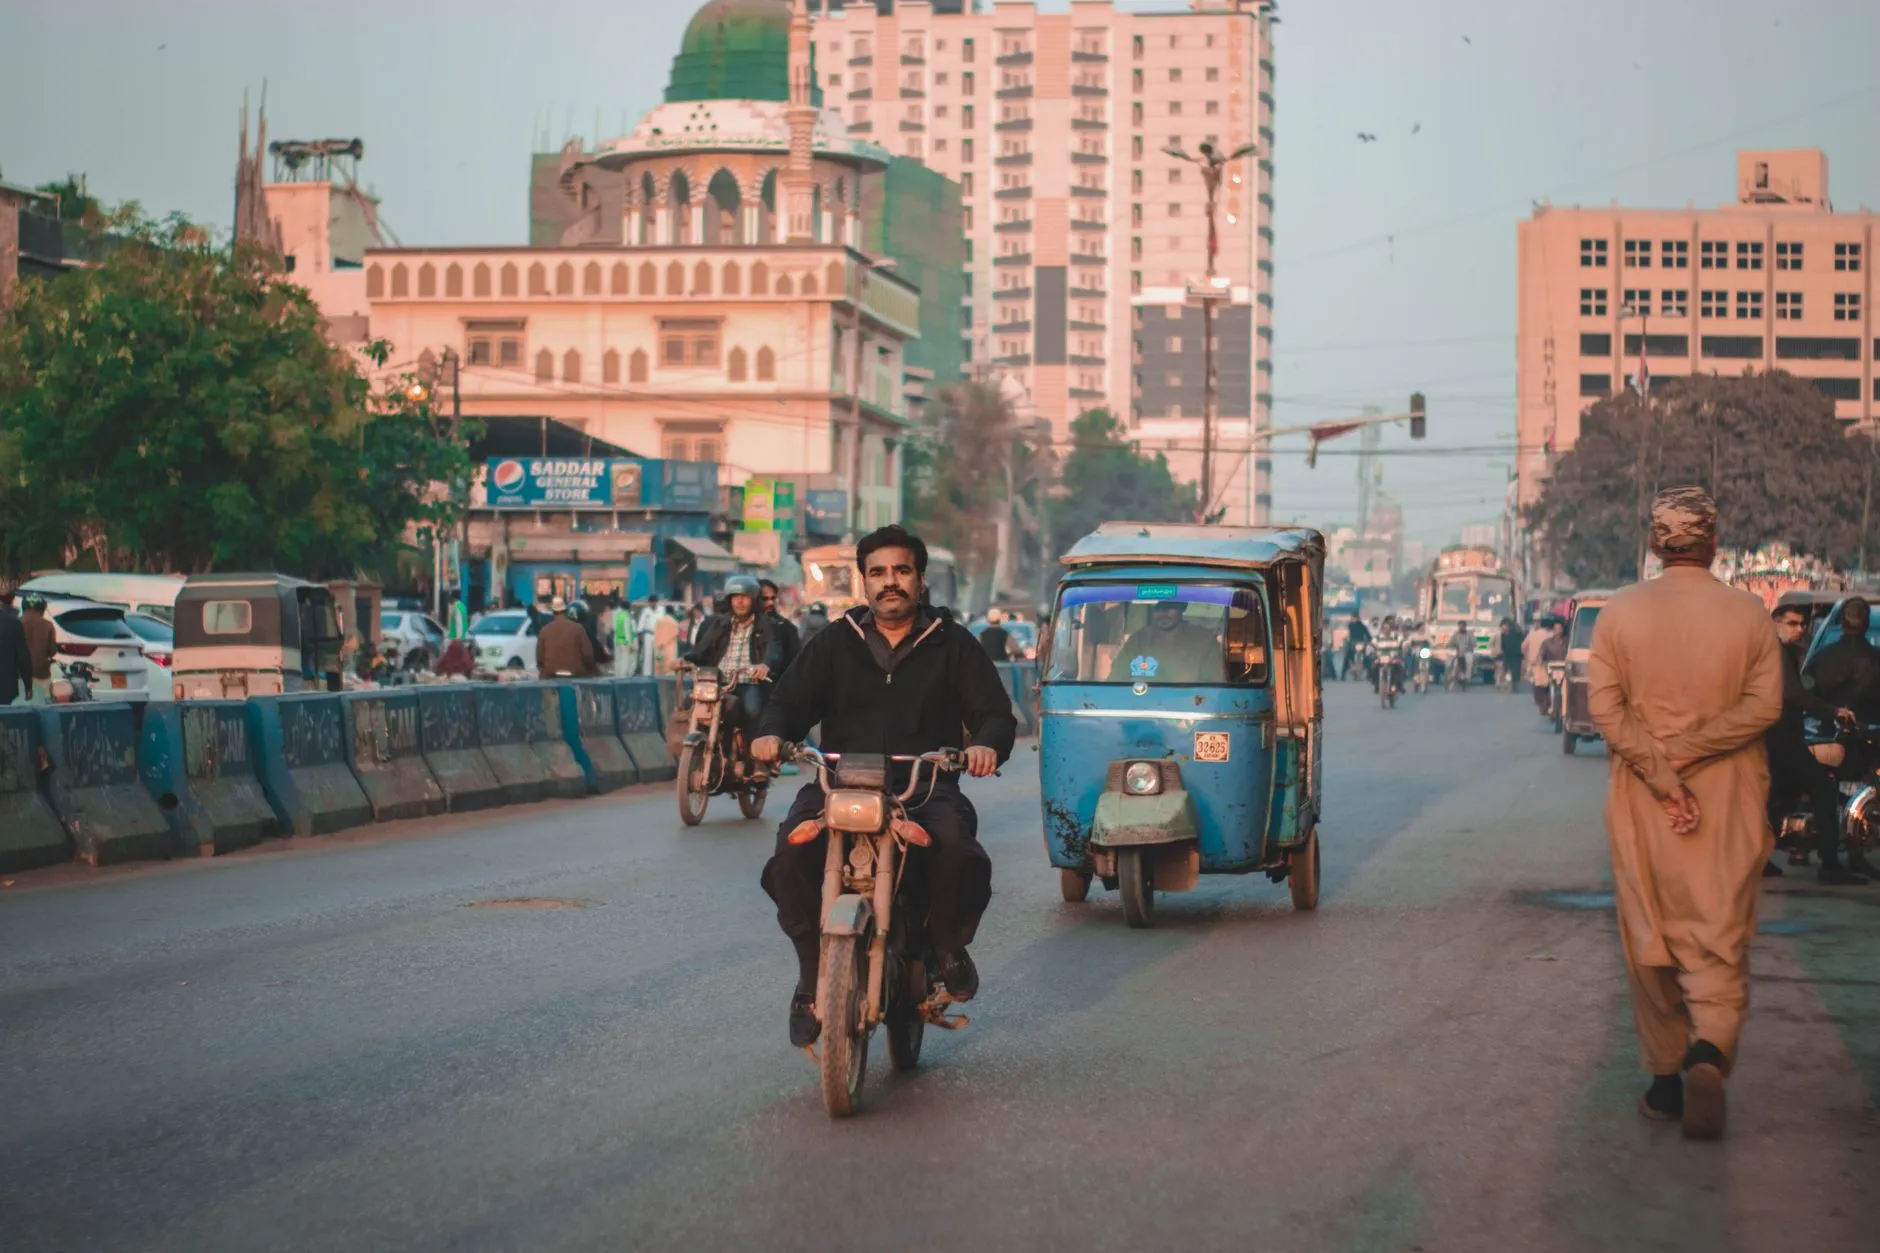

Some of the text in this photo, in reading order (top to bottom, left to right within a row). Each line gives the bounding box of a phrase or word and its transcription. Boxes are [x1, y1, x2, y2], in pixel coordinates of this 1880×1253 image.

[530, 461, 605, 476] SADDAR
[535, 476, 599, 488] GENERAL
[544, 488, 591, 501] STORE
[1197, 741, 1226, 753] 32625
